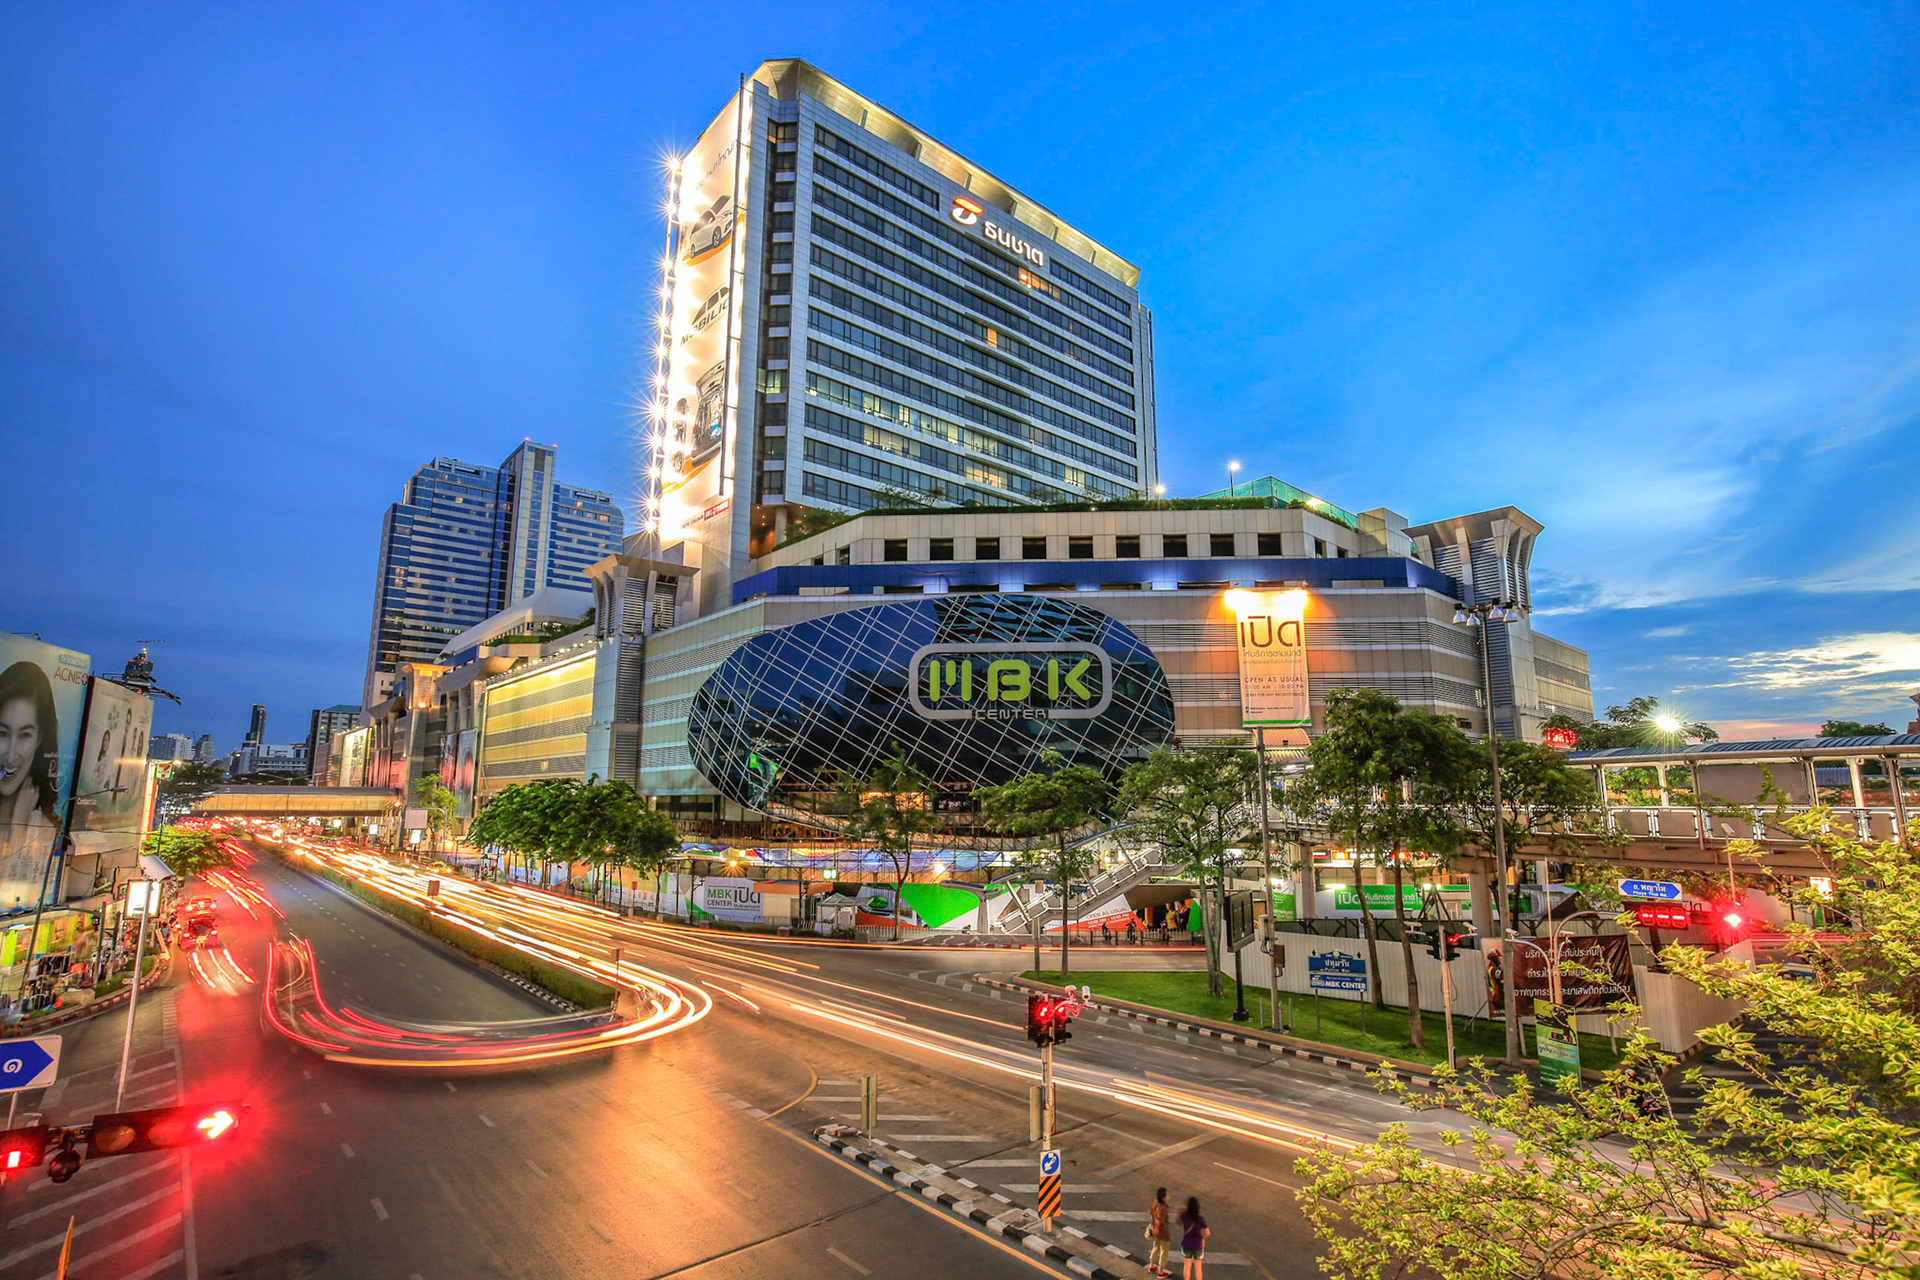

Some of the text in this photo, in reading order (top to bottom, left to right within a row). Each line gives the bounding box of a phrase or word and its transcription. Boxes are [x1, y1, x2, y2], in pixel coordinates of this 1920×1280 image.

[985, 221, 1044, 267] ธนชาต
[1240, 615, 1302, 648] เปิด
[929, 658, 1091, 702] MBK
[974, 709, 1047, 720] CENTER
[708, 888, 732, 899] MBK
[1641, 883, 1667, 893] พญาไท
[734, 886, 761, 904] เปิด
[707, 899, 732, 907] CENTER
[1325, 980, 1340, 988] MBK
[1341, 981, 1367, 989] CENTER
